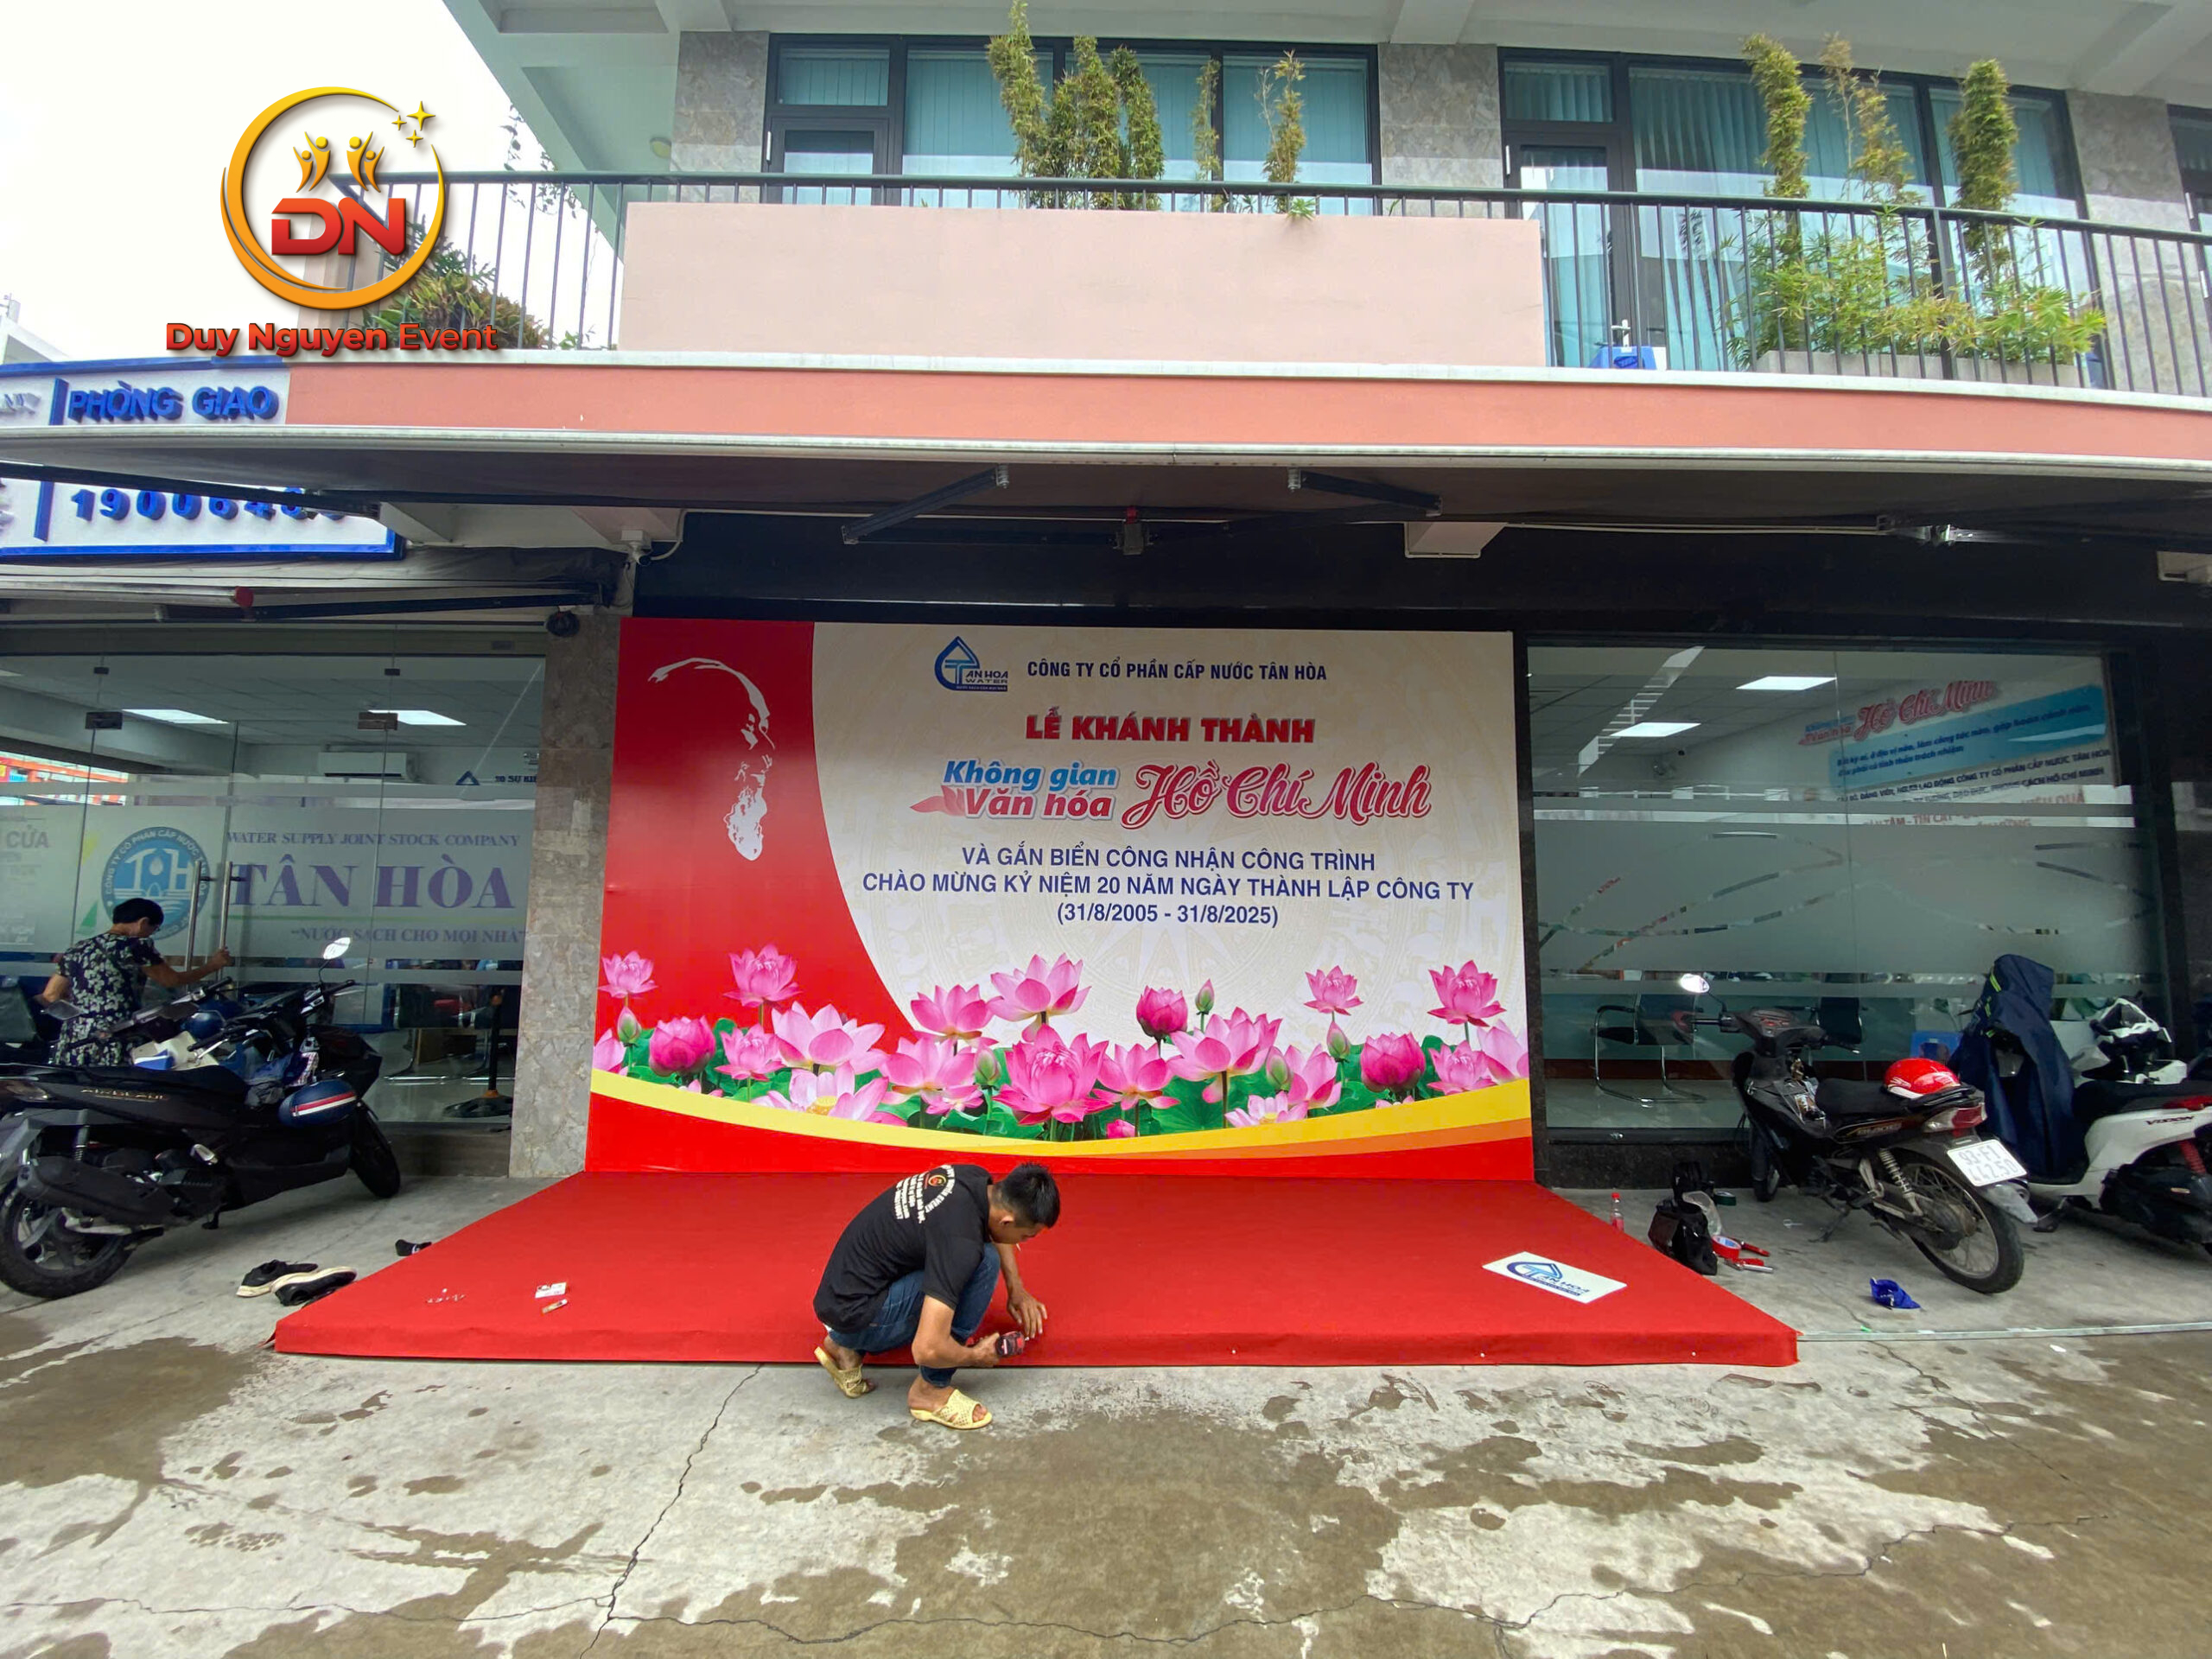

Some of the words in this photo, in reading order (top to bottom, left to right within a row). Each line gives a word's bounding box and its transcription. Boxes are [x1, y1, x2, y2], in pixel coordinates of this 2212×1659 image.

[67, 380, 183, 423] PHÒNG
[192, 385, 279, 421] GIAO
[1027, 658, 1071, 677] CÔNG
[1076, 662, 1094, 677] TY
[1099, 657, 1121, 677] CỔ
[1127, 658, 1167, 678] PHẦN
[1174, 658, 1205, 678] CẤP
[1211, 661, 1253, 681] NƯỚC
[1260, 660, 1288, 680] TÂN
[1295, 661, 1327, 681] HÒA
[1026, 706, 1061, 740] LỄ
[1071, 711, 1192, 742] KHÁNH
[1201, 713, 1316, 743] THÀNH
[944, 760, 1042, 791] Không
[1048, 762, 1117, 791] gian
[965, 786, 1034, 817] Văn
[1043, 790, 1114, 817] hóa
[1121, 760, 1222, 829] Hồ
[1222, 762, 1314, 819] Chí
[1297, 760, 1433, 826] Minh
[226, 833, 276, 844] WATER
[282, 834, 336, 846] SUPPLY
[340, 834, 386, 846] JOINT
[389, 834, 439, 846] STOCK
[444, 834, 520, 848] COMPANY
[962, 843, 990, 865] VÀ
[997, 841, 1043, 866] GẮN
[1051, 842, 1099, 867] BIỂN
[1106, 846, 1167, 868] CÔNG
[1175, 847, 1235, 872] NHẬN
[1242, 849, 1304, 870] CÔNG
[1311, 849, 1376, 871] TRÌNH
[230, 853, 359, 907] TÂN
[372, 853, 518, 909] HÒA
[862, 869, 925, 892] CHÀO
[932, 872, 996, 893] MỪNG
[1004, 870, 1032, 893] KỶ
[1039, 872, 1090, 898] NIỆM
[1097, 877, 1120, 893] 20
[1128, 874, 1173, 894] NĂM
[1181, 874, 1241, 896] NGÀY
[1248, 875, 1321, 897] THÀNH
[1328, 877, 1370, 901] LẬP
[1376, 877, 1440, 899] CÔNG
[1447, 882, 1474, 899] TY
[1058, 902, 1158, 925] (31/8/2005
[1178, 905, 1278, 928] 31/8/2025)
[401, 928, 439, 943] CHO
[443, 929, 480, 944] MỌI
